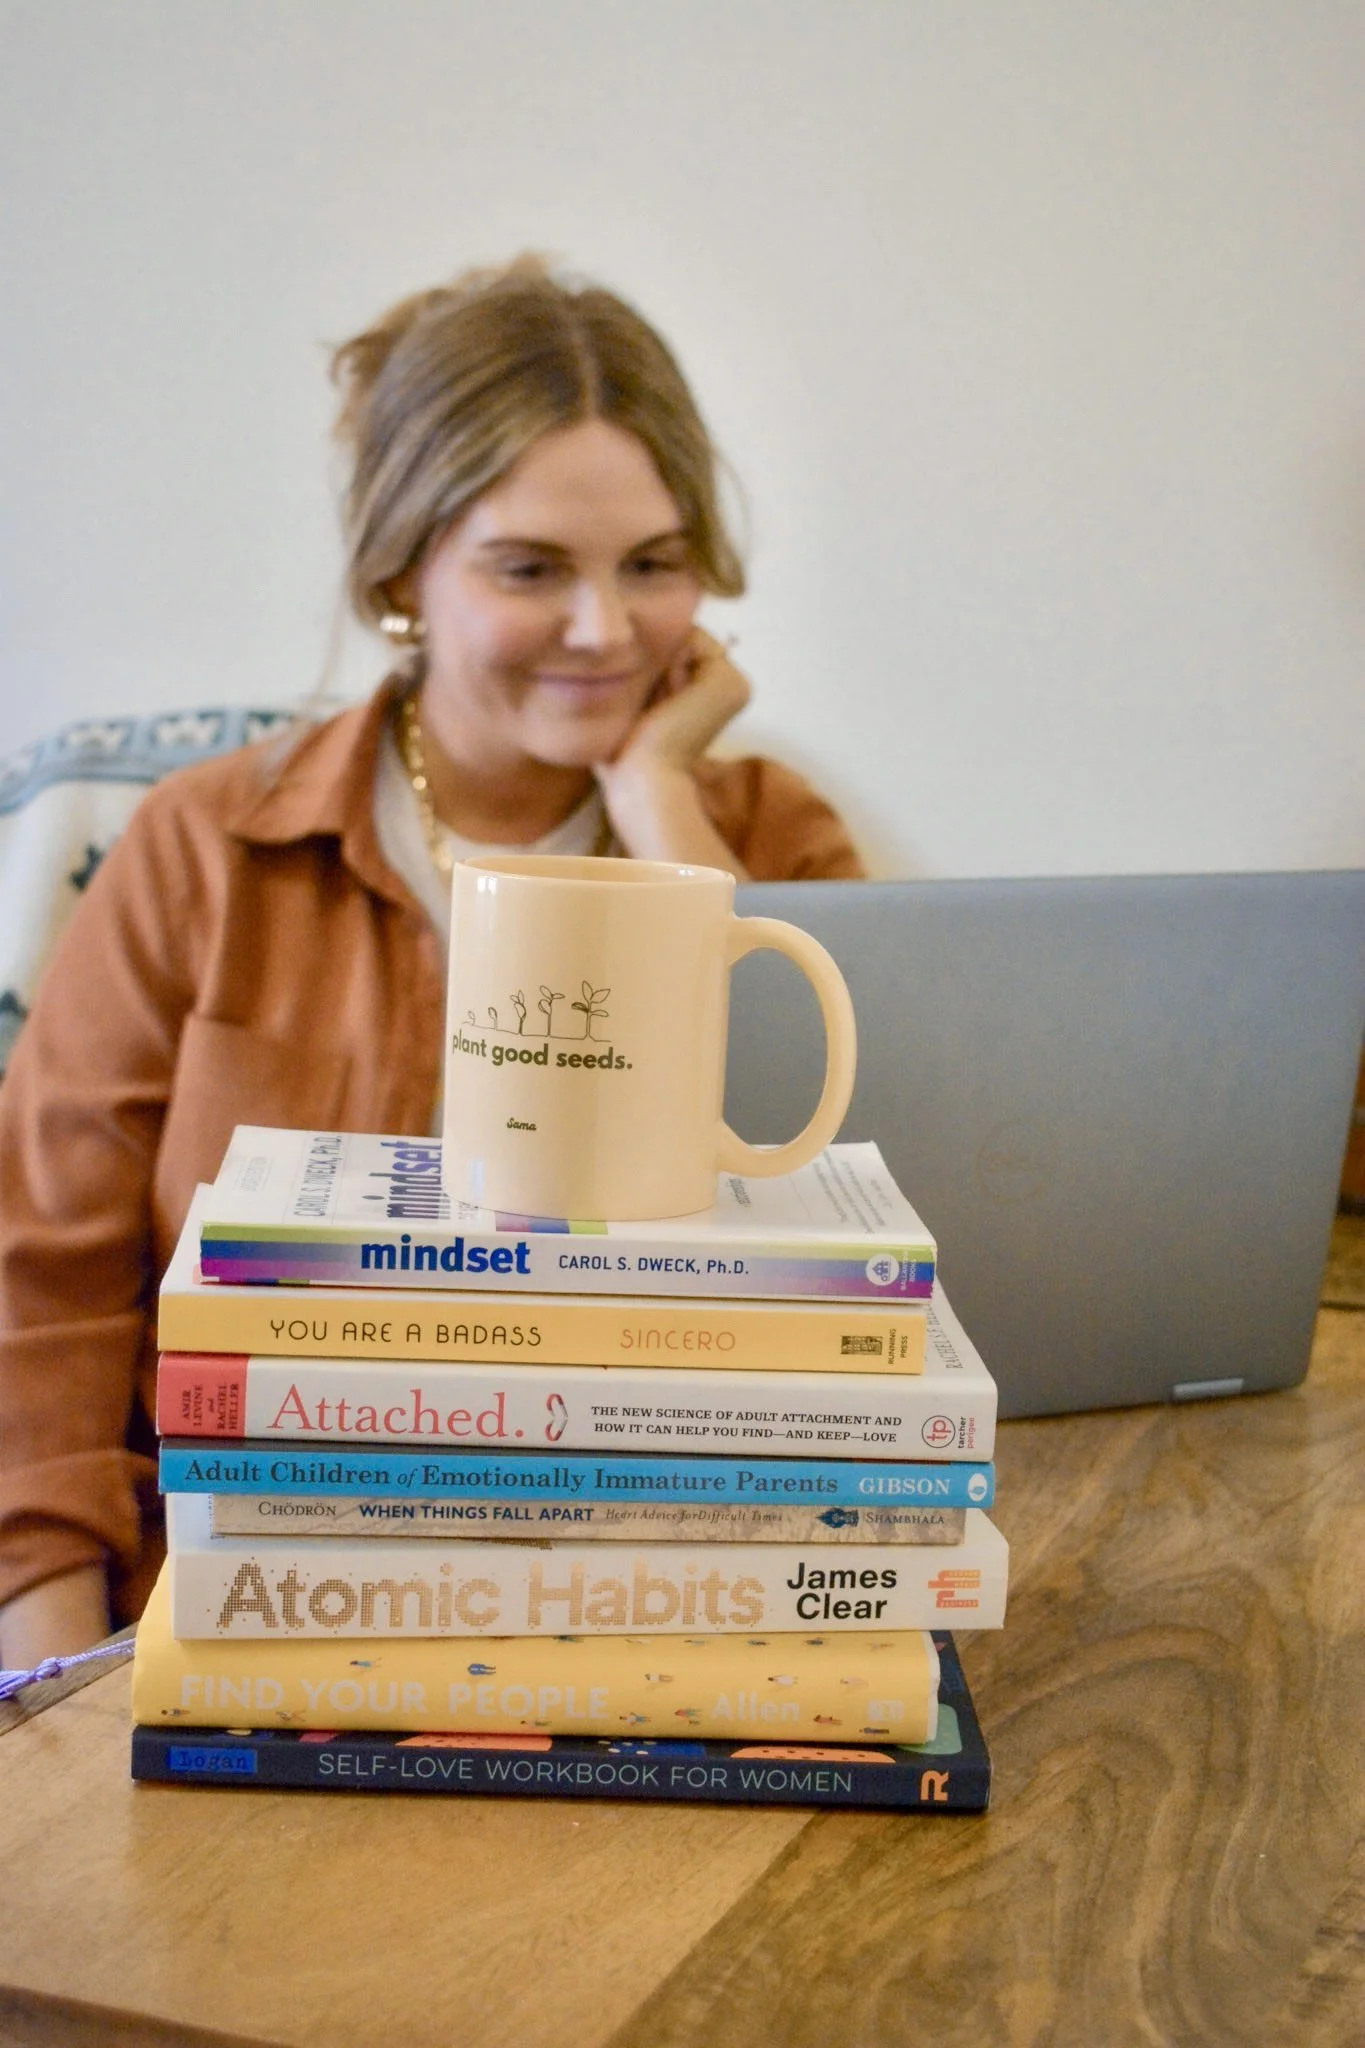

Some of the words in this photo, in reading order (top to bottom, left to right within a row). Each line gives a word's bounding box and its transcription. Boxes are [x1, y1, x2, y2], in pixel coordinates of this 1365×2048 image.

[452, 1029, 487, 1057] plant
[491, 1043, 549, 1066] good
[555, 1046, 633, 1069] seeds.
[506, 1117, 537, 1131] Sama
[361, 1141, 446, 1219] mindset
[361, 1233, 531, 1274] mindset
[558, 1254, 612, 1271] CAROL
[617, 1256, 631, 1271] S.
[637, 1257, 701, 1275] DWECK,
[707, 1258, 749, 1275] Ph.D.
[270, 1319, 329, 1341] YOU
[342, 1321, 392, 1343] ARE
[406, 1323, 422, 1344] A
[436, 1324, 542, 1347] BADASS
[619, 1328, 737, 1352] SINCERO
[888, 1328, 897, 1365] RUNNING
[900, 1335, 909, 1359] PRESS
[267, 1384, 525, 1439] Attached.
[592, 1406, 618, 1416] THE
[622, 1407, 652, 1418] NEW
[656, 1408, 712, 1420] SCIENCE
[715, 1409, 732, 1420] OF
[736, 1410, 778, 1422] ADULT
[781, 1411, 872, 1425] ATTACHMENT
[874, 1415, 902, 1426] AND
[594, 1423, 627, 1434] HOW
[629, 1424, 644, 1434] IT
[646, 1424, 673, 1435] CAN
[675, 1425, 710, 1436] HELP
[712, 1426, 739, 1437] YOU
[958, 1416, 967, 1449] tarcher
[967, 1416, 976, 1449] perigee
[185, 1459, 262, 1483] Adult
[270, 1462, 391, 1485] Children
[397, 1464, 418, 1487] of
[421, 1465, 586, 1493] Emotionally
[594, 1468, 727, 1492] Immature
[735, 1470, 839, 1493] Parents
[859, 1477, 952, 1497] GIBSON
[358, 1505, 415, 1519] WHEN
[421, 1506, 488, 1521] THINGS
[492, 1507, 534, 1521] FALL
[539, 1507, 595, 1522] APART
[605, 1508, 637, 1520] Heart
[698, 1510, 747, 1524] Difficult
[751, 1510, 783, 1522] Times
[786, 1562, 898, 1590] James
[216, 1560, 501, 1629] Atomic
[526, 1559, 766, 1628] Habits
[796, 1592, 888, 1620] Clear
[181, 1676, 284, 1710] FIND
[300, 1679, 429, 1715] YOUR
[449, 1683, 610, 1721] PEOPLE
[711, 1691, 799, 1723] Allen
[179, 1751, 247, 1773] Logan
[318, 1753, 473, 1779] SELF-LOVE
[485, 1759, 660, 1787] WORKBOOK
[671, 1766, 728, 1789] FOR
[738, 1768, 853, 1793] WOMEN
